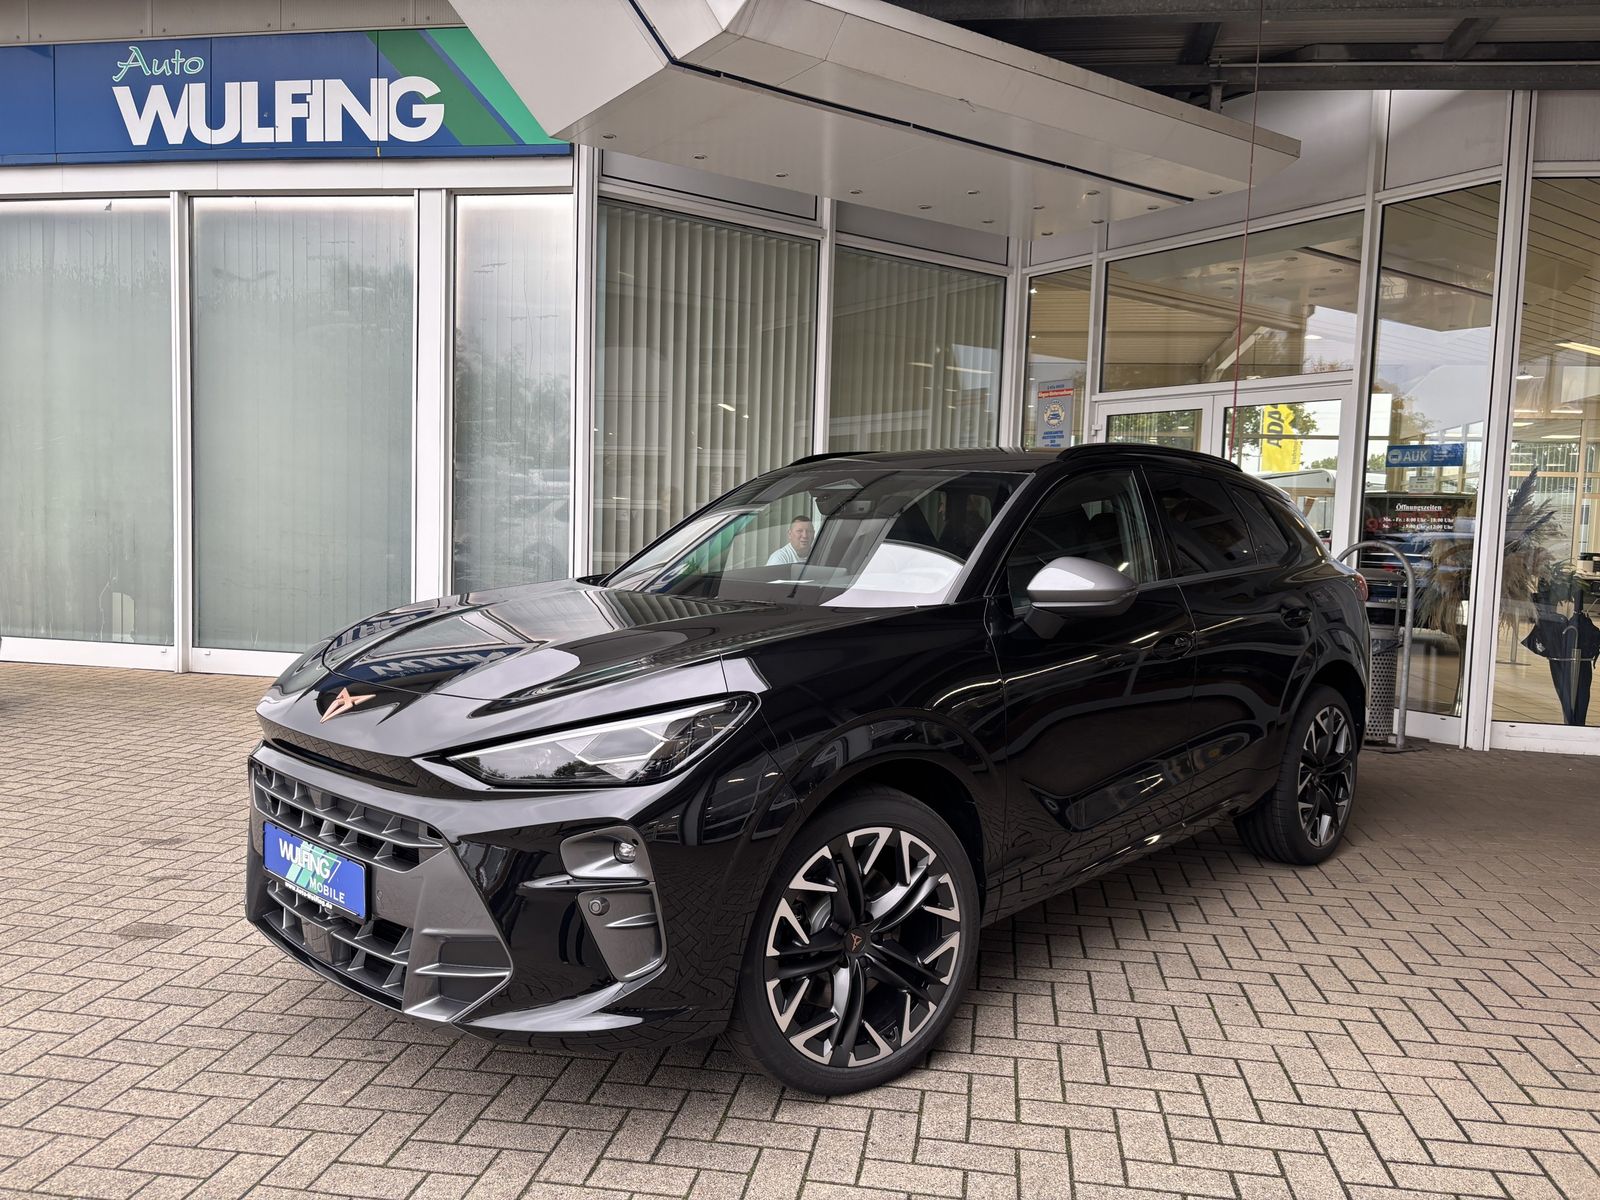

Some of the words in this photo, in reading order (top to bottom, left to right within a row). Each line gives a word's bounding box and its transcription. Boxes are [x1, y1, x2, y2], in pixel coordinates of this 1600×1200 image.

[112, 45, 205, 82] Auto
[111, 76, 445, 146] WULFING
[1265, 404, 1285, 449] ADA
[1395, 503, 1442, 512] Öffnungszeiten
[278, 838, 331, 879] WULFING
[309, 876, 346, 905] MOBILE
